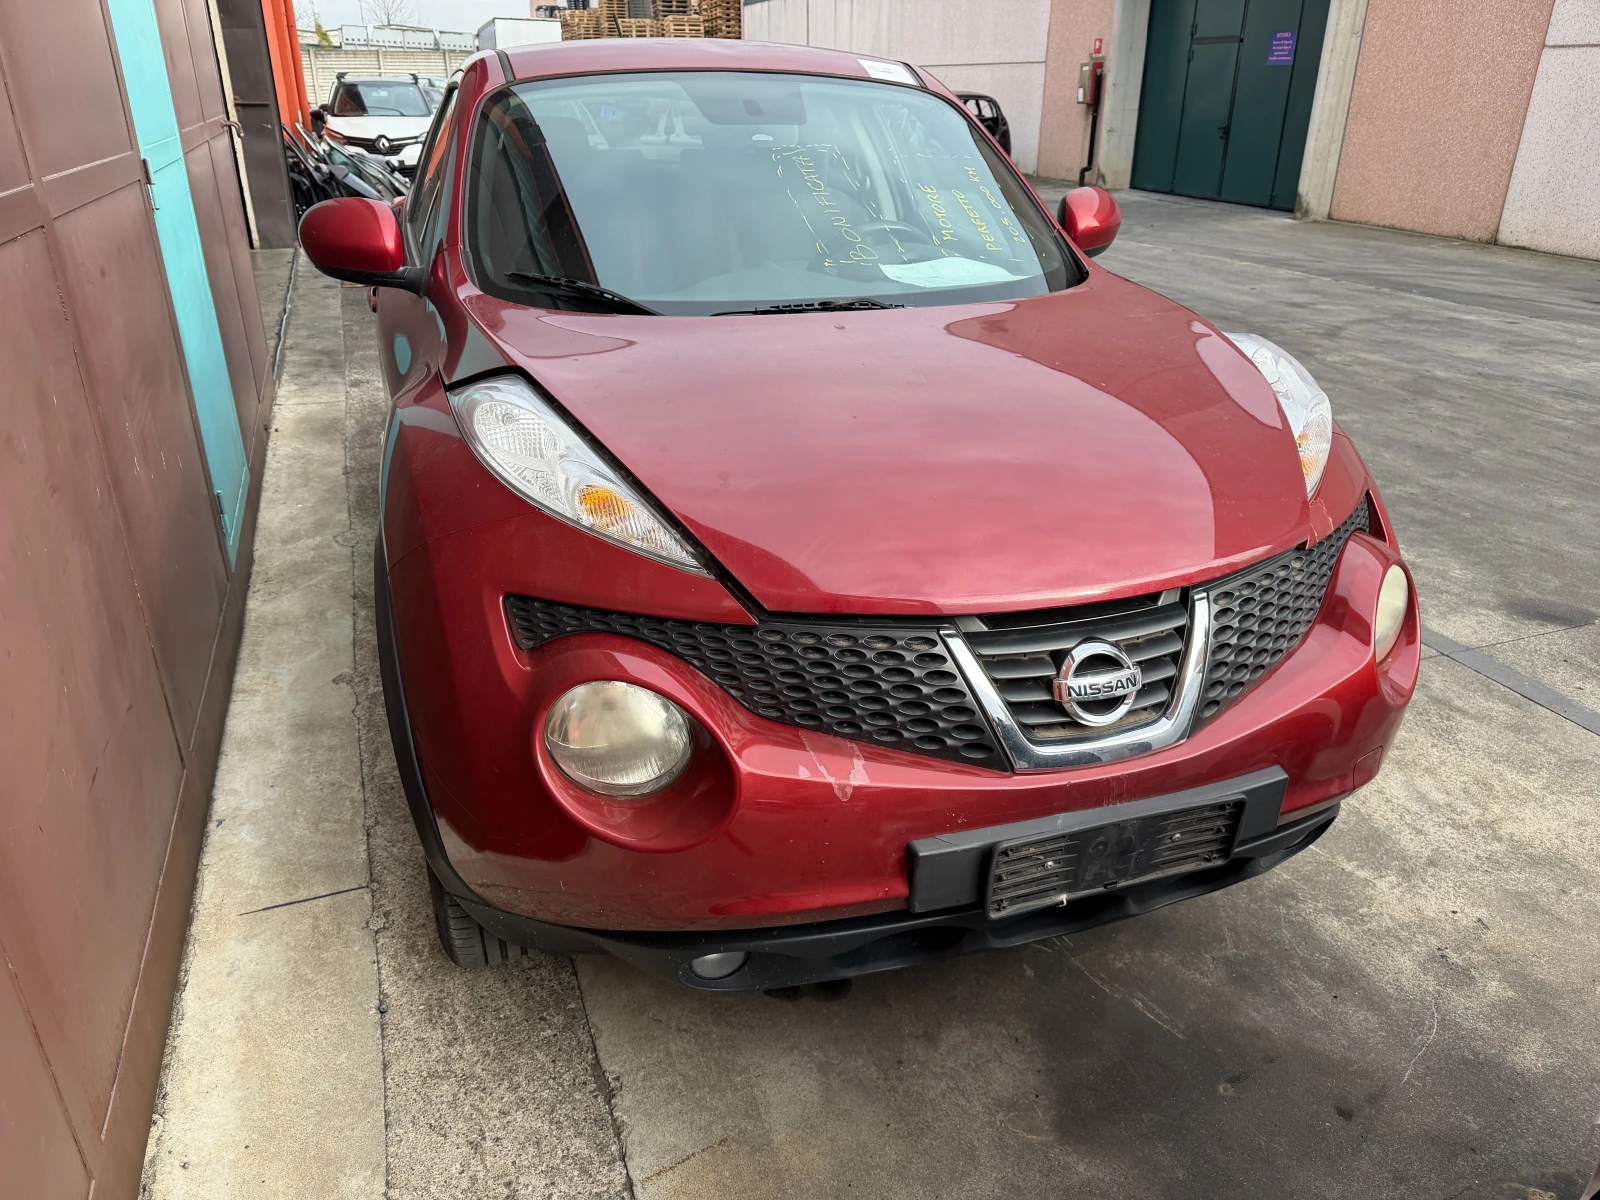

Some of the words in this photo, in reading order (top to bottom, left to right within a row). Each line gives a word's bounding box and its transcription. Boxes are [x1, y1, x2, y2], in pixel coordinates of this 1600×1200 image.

[964, 166, 980, 183] KM
[792, 155, 878, 260] BONIFICATA
[917, 183, 958, 241] MOTORE
[951, 189, 1002, 251] PERFETTO
[980, 186, 1025, 243] 205.000
[1067, 675, 1137, 697] NISSAN
